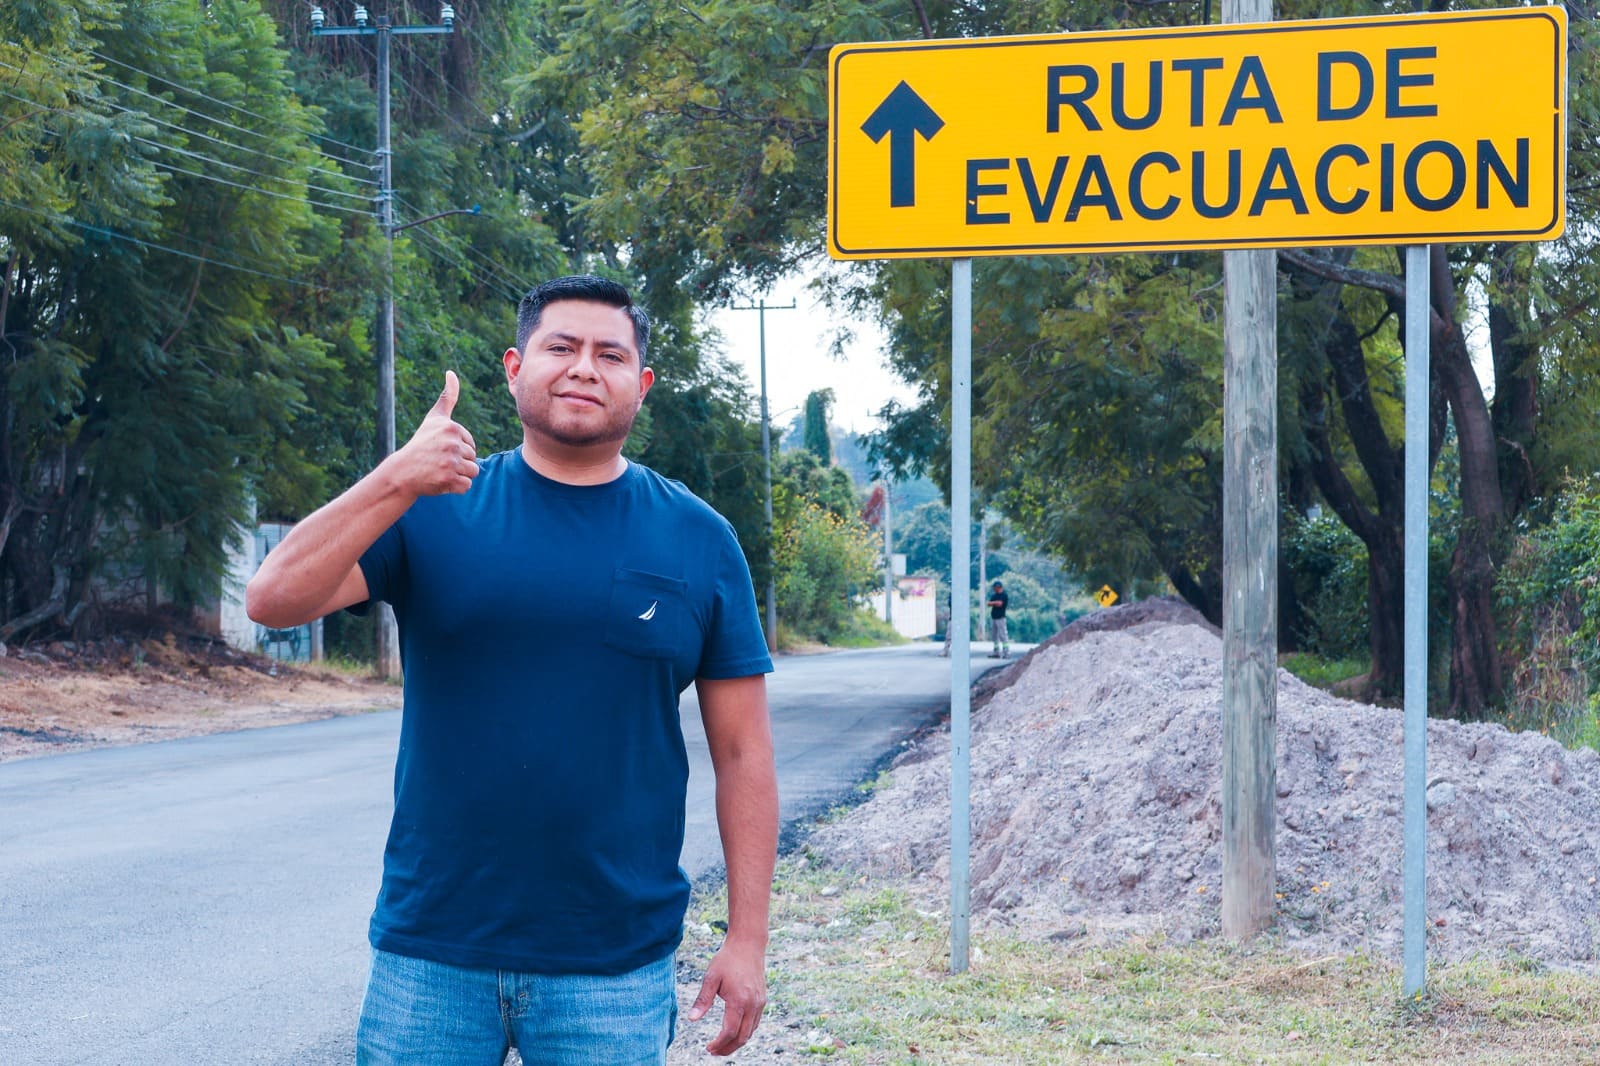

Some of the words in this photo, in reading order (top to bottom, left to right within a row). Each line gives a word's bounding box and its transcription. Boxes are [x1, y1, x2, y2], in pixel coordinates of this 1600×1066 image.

[1046, 55, 1284, 133] RUTA
[1317, 46, 1438, 122] DE
[965, 137, 1530, 225] EVACUACION
